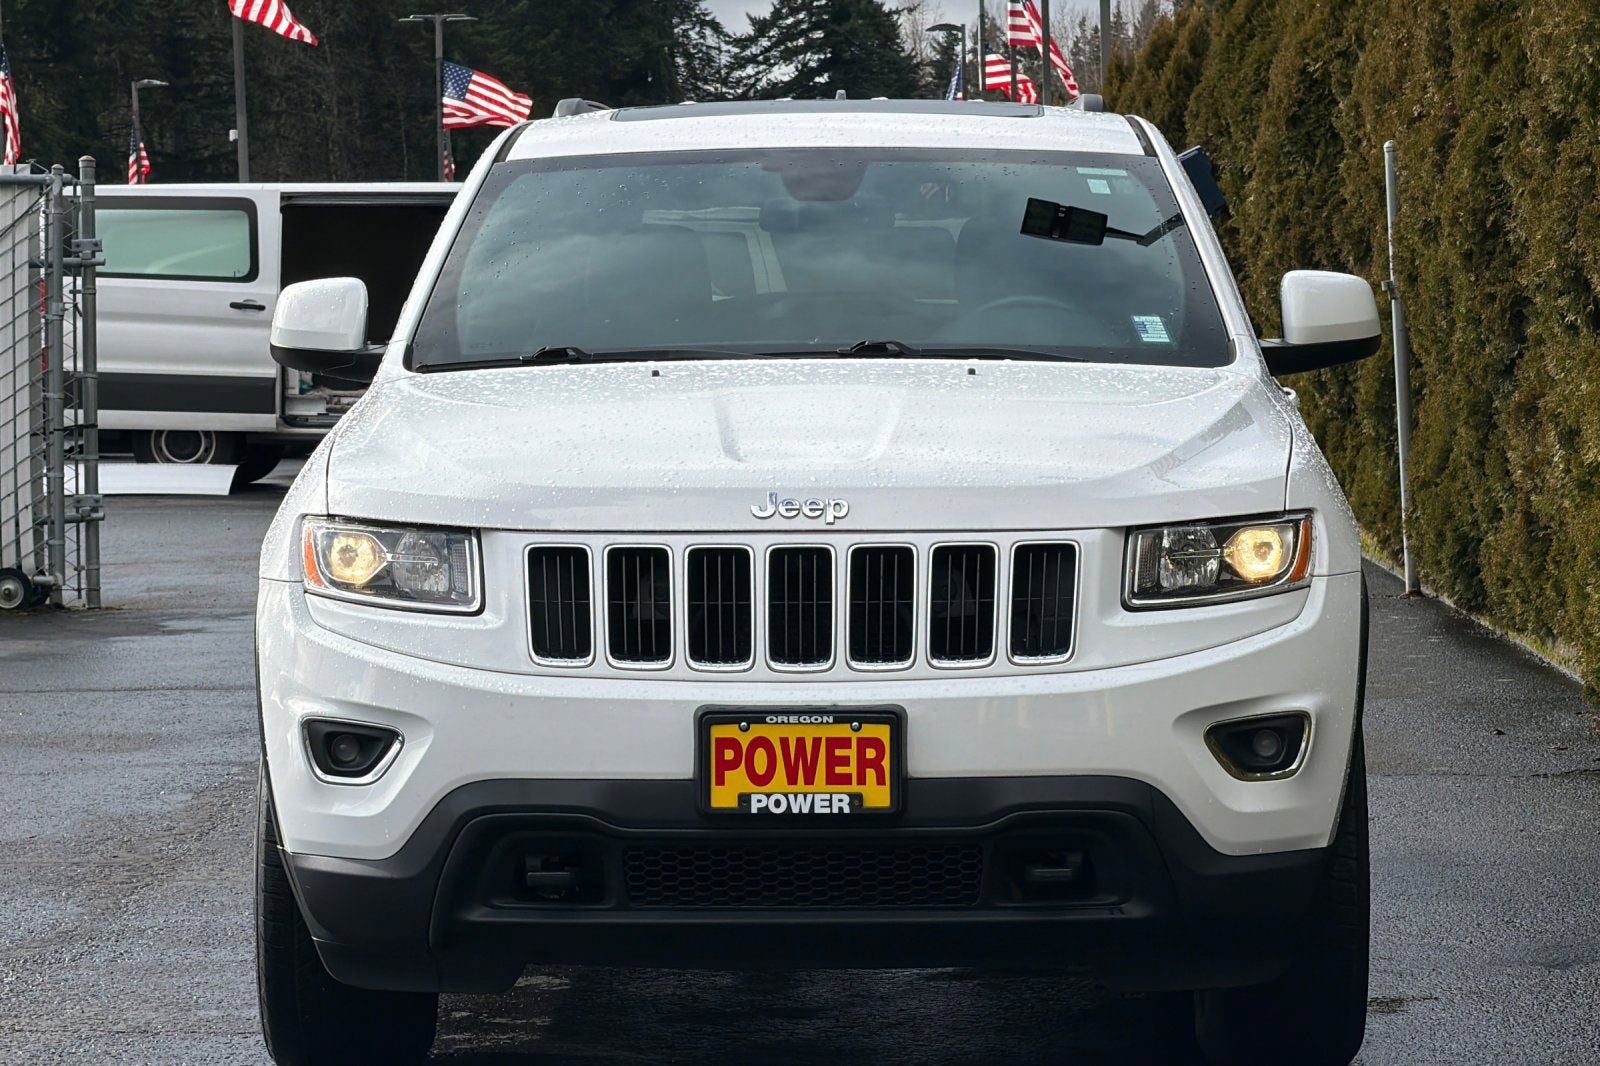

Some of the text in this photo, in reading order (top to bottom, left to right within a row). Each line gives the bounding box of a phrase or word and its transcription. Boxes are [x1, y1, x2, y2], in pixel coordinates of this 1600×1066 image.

[750, 490, 849, 525] Jeep
[765, 715, 834, 724] OREGON
[714, 736, 887, 787] POWER
[750, 794, 850, 814] POWER
